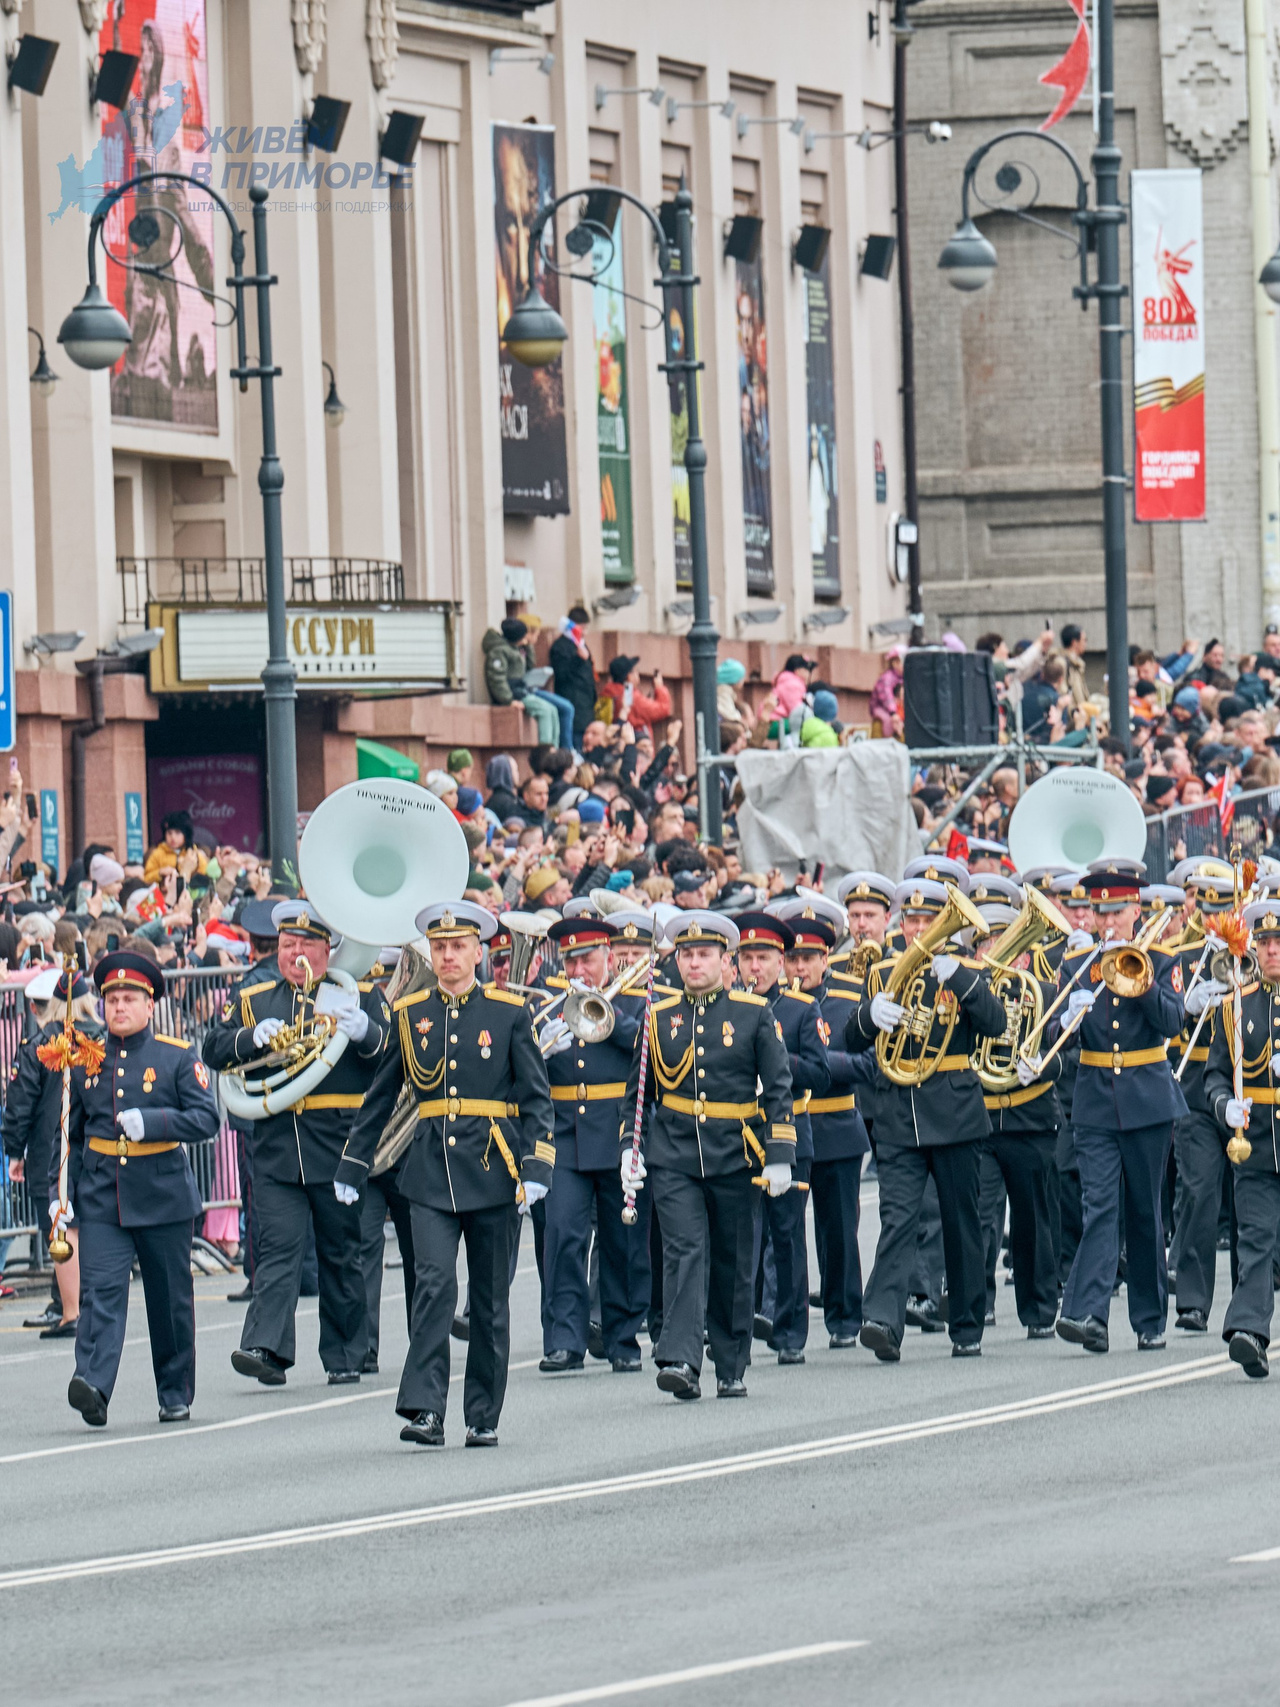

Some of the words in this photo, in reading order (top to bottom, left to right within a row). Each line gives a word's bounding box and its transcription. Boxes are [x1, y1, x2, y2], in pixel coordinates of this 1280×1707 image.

[1143, 297, 1172, 324] 80
[1143, 326, 1199, 342] ПОБЕДА!
[356, 788, 436, 812] ТИХООКЕАНСКИЙ
[381, 803, 405, 815] ФЛОТ
